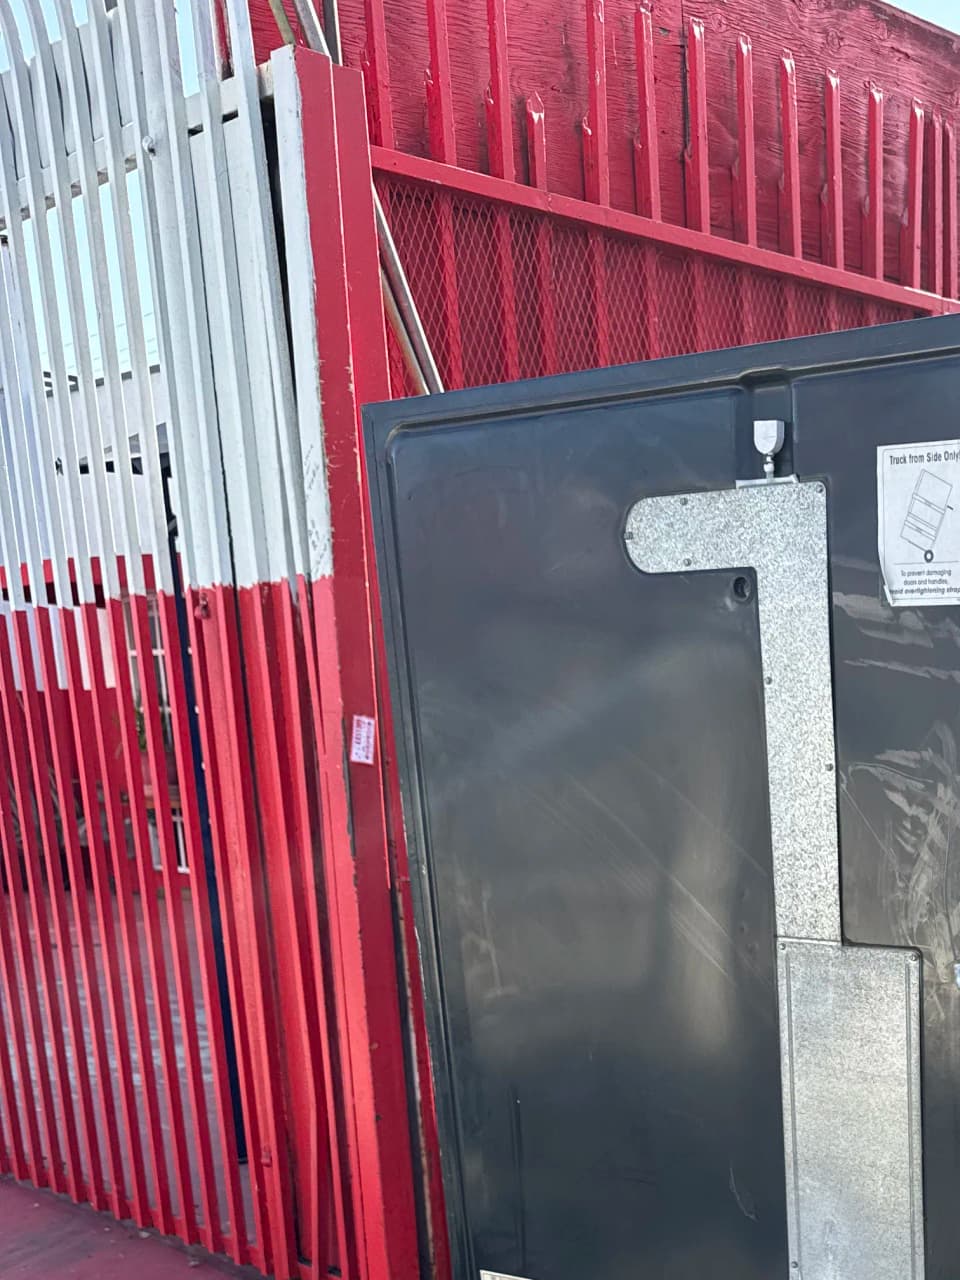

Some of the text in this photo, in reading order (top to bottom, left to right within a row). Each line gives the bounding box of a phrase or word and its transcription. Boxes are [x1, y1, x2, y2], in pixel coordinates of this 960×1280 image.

[889, 453, 907, 465] Truck
[908, 453, 925, 464] from
[926, 451, 942, 463] Side
